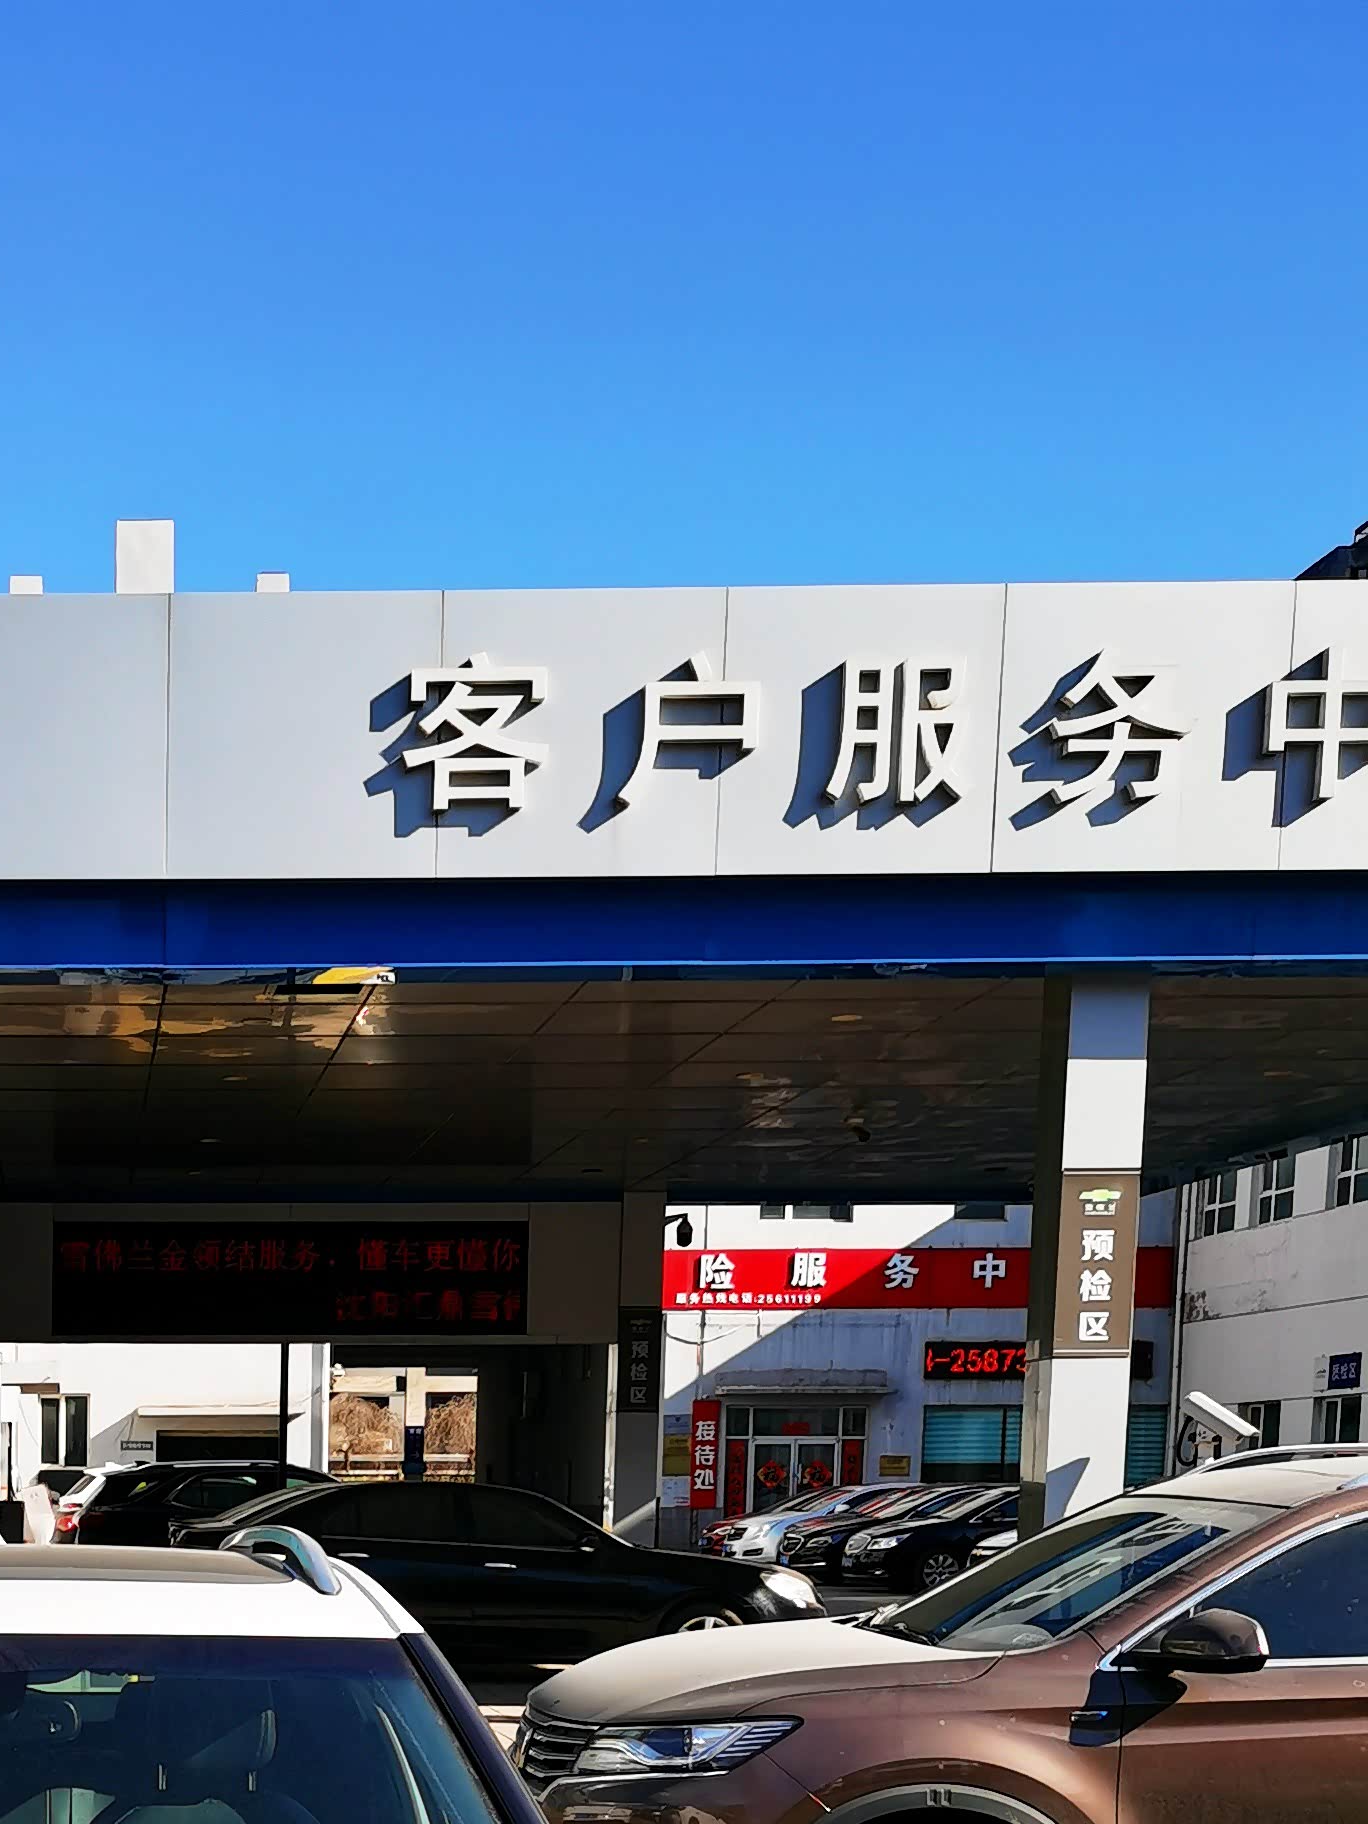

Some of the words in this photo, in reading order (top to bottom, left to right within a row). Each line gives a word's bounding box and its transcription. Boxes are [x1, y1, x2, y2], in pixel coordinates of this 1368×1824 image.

[400, 645, 1368, 811] 客户服务中
[1079, 1229, 1115, 1341] 预检区
[694, 1421, 716, 1490] 接待处
